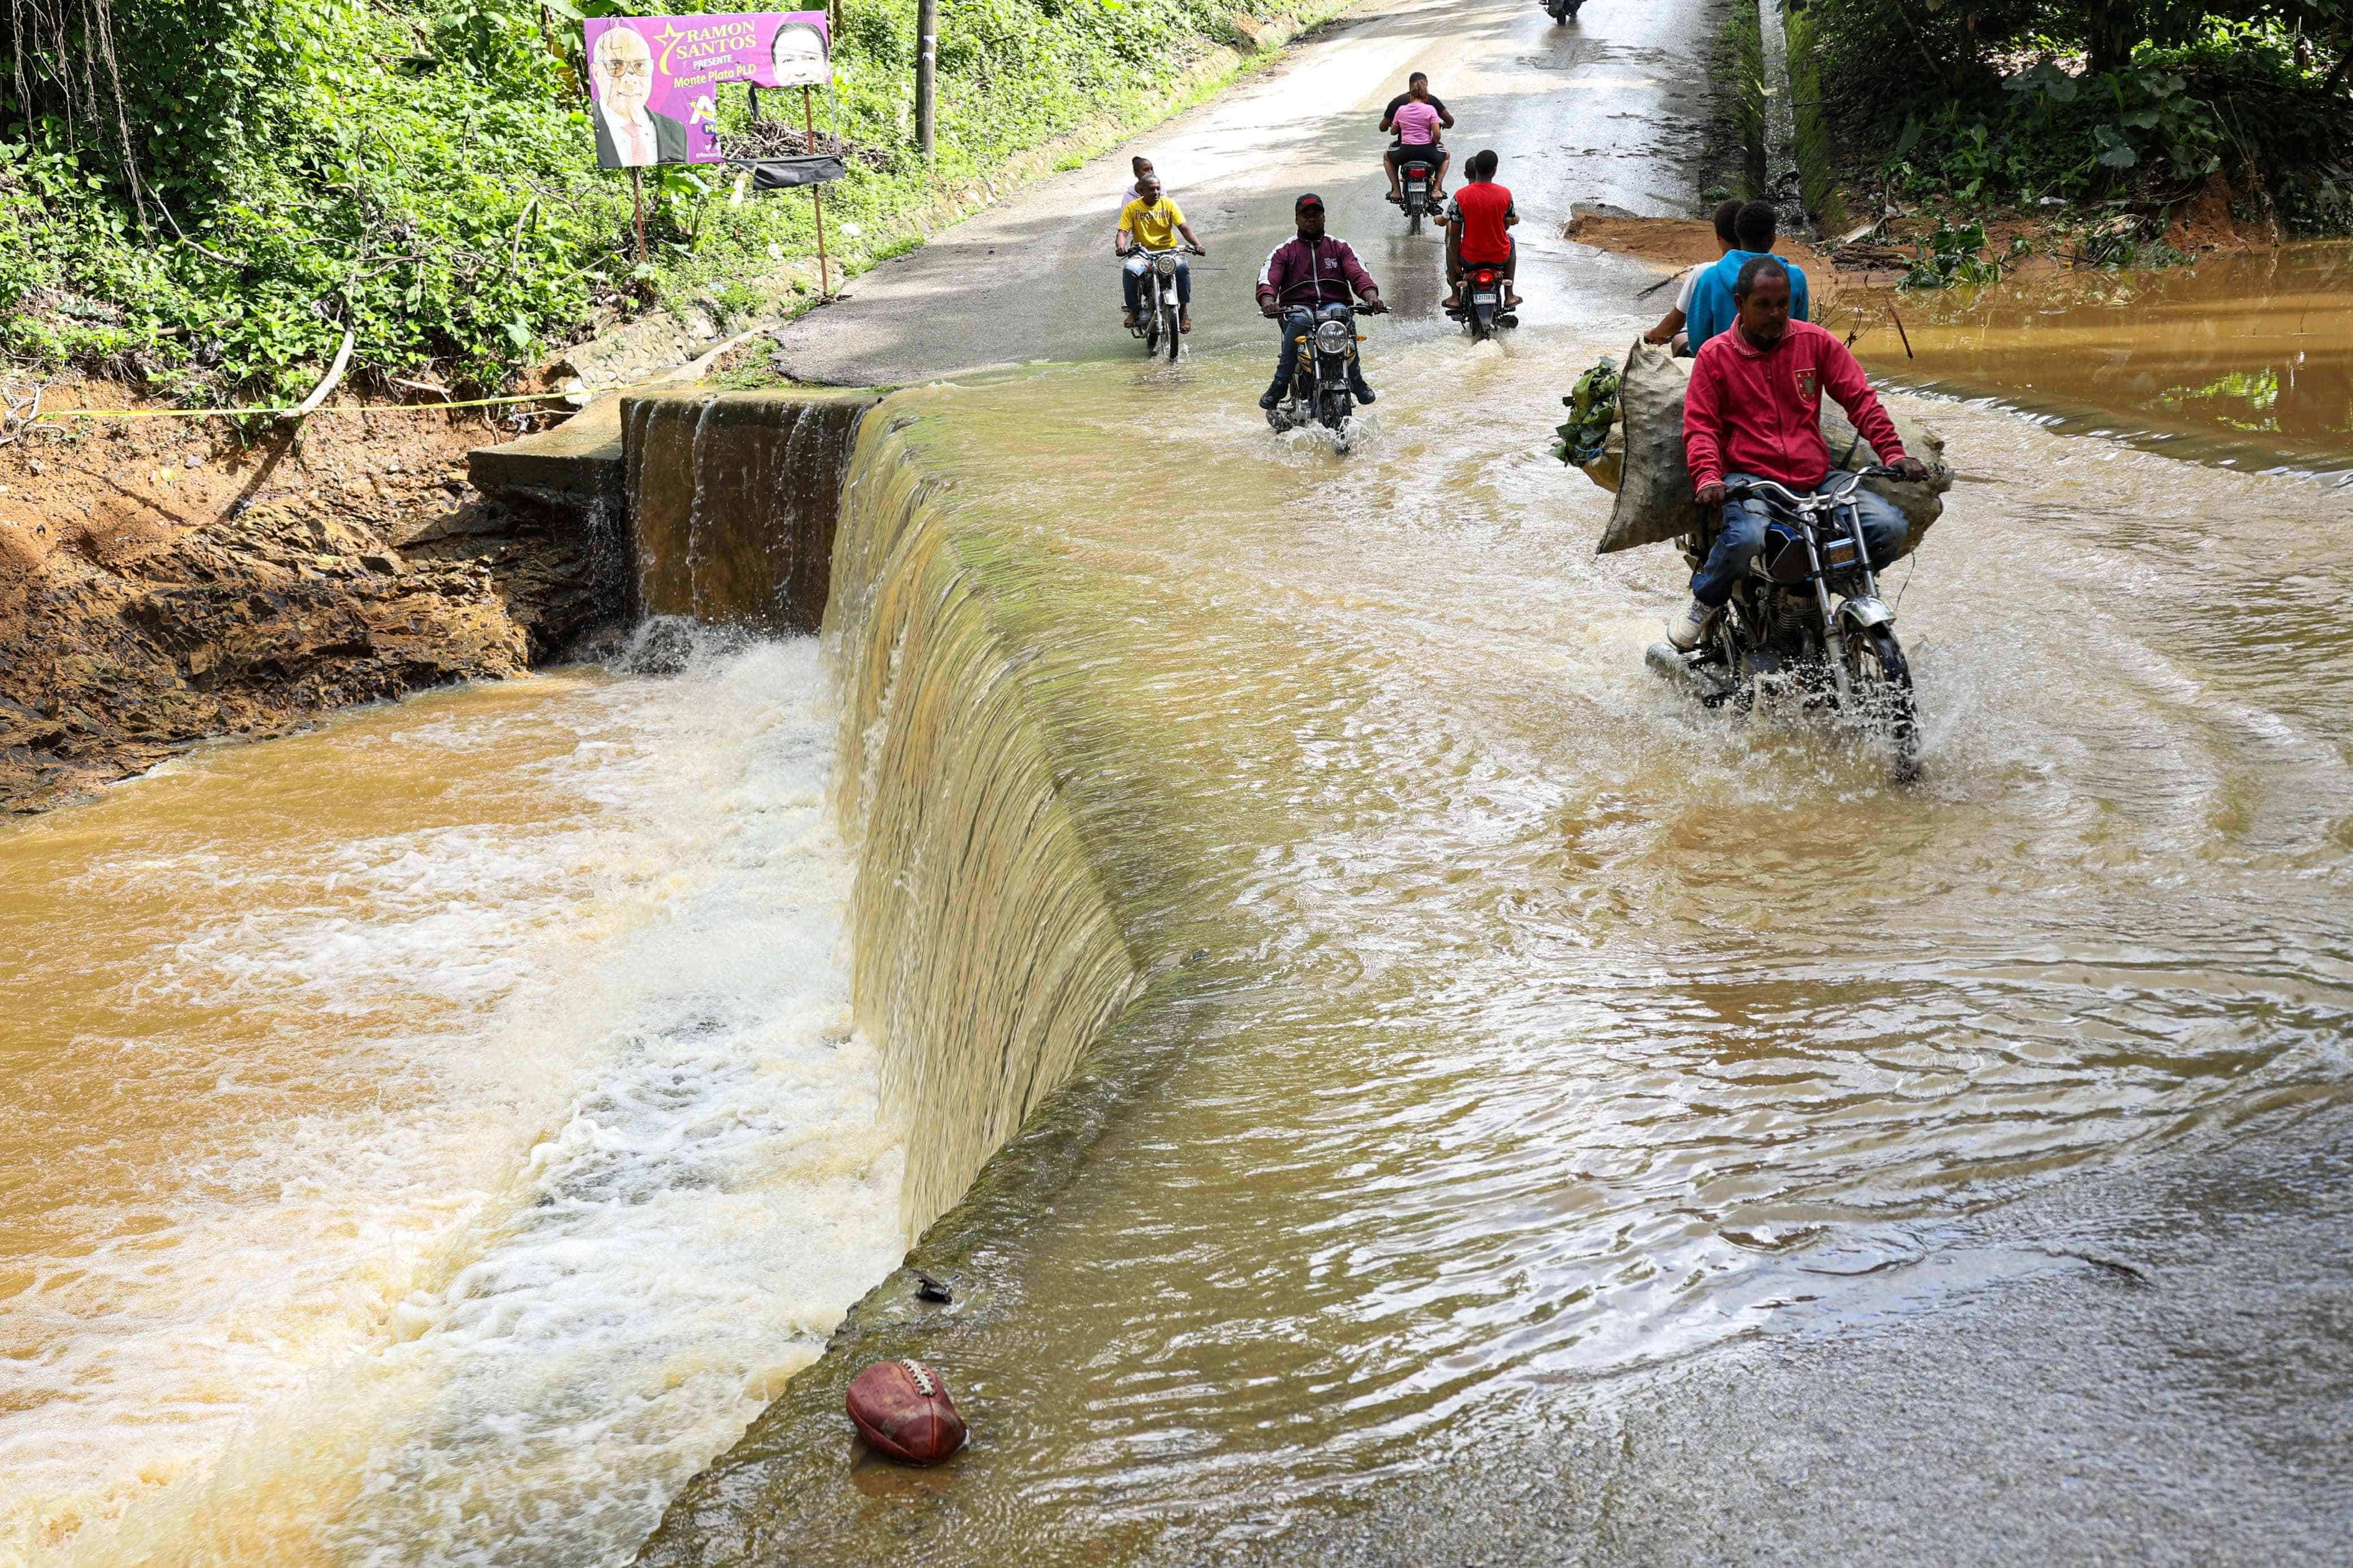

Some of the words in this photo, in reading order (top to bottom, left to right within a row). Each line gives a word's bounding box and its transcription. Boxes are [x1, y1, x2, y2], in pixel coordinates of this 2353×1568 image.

[687, 20, 755, 42] RAMON
[676, 34, 757, 59] SANTOS
[693, 55, 732, 68] PRESENTE
[674, 75, 706, 88] Monte
[708, 67, 734, 81] Plata
[736, 63, 757, 77] PLD
